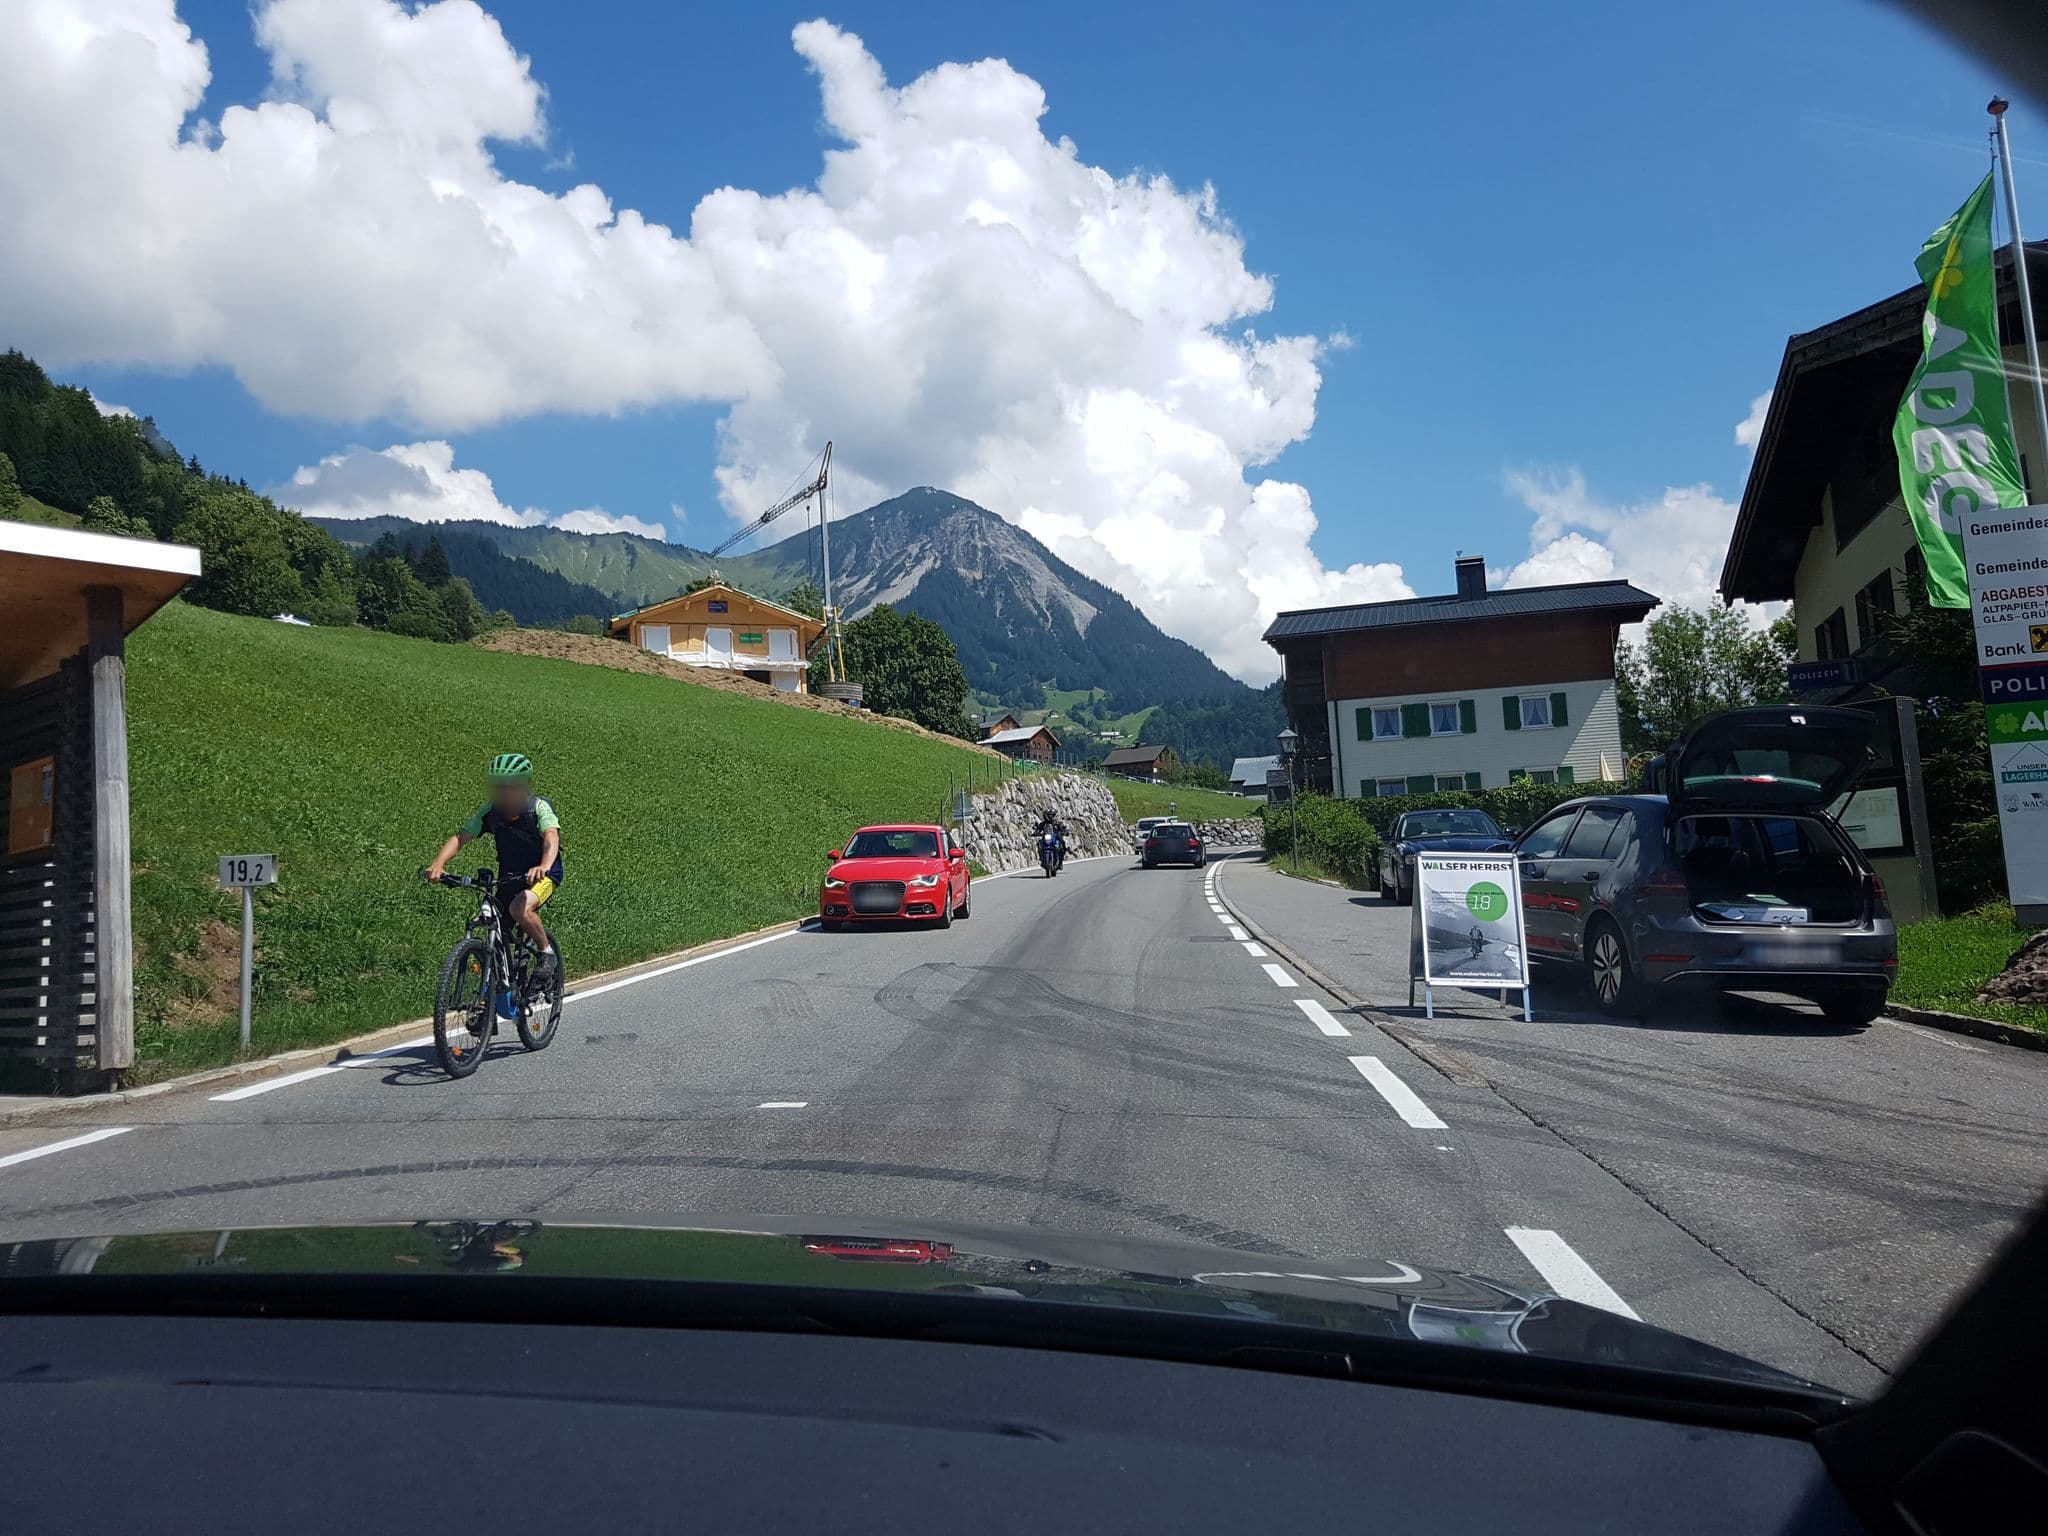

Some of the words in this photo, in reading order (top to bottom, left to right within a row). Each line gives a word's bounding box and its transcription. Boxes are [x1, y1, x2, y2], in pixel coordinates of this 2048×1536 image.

[1975, 557, 2048, 575] Gemeinde
[1983, 608, 2048, 624] GLAS-GRÜ
[1984, 642, 2026, 658] Bank
[1792, 669, 1834, 681] POLIZEI
[228, 859, 264, 884] 19,2
[1422, 862, 1468, 871] WALSER
[1470, 863, 1513, 872] HERBST
[1471, 895, 1491, 910] 18
